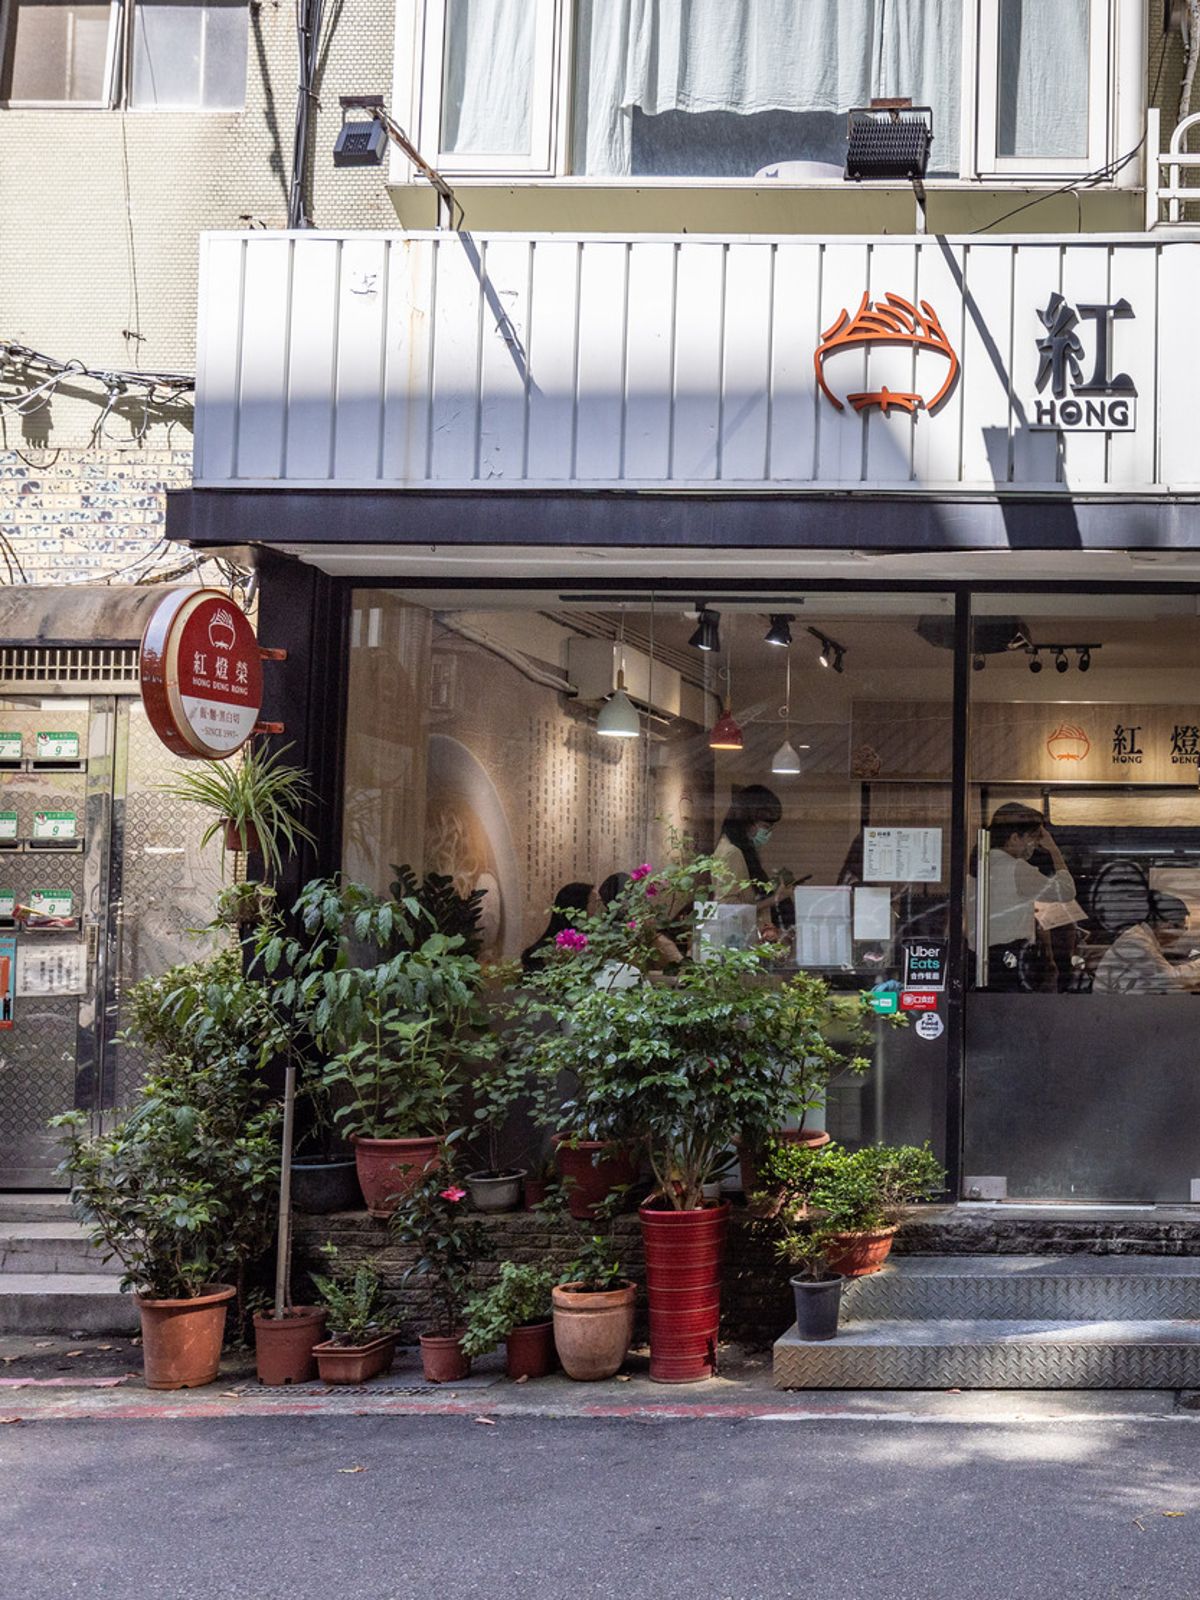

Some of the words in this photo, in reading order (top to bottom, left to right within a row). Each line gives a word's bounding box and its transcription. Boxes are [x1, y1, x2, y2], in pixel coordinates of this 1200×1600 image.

[1034, 400, 1129, 426] HONG
[1112, 756, 1142, 764] HONG
[910, 946, 940, 957] Uber
[910, 959, 940, 969] Eats
